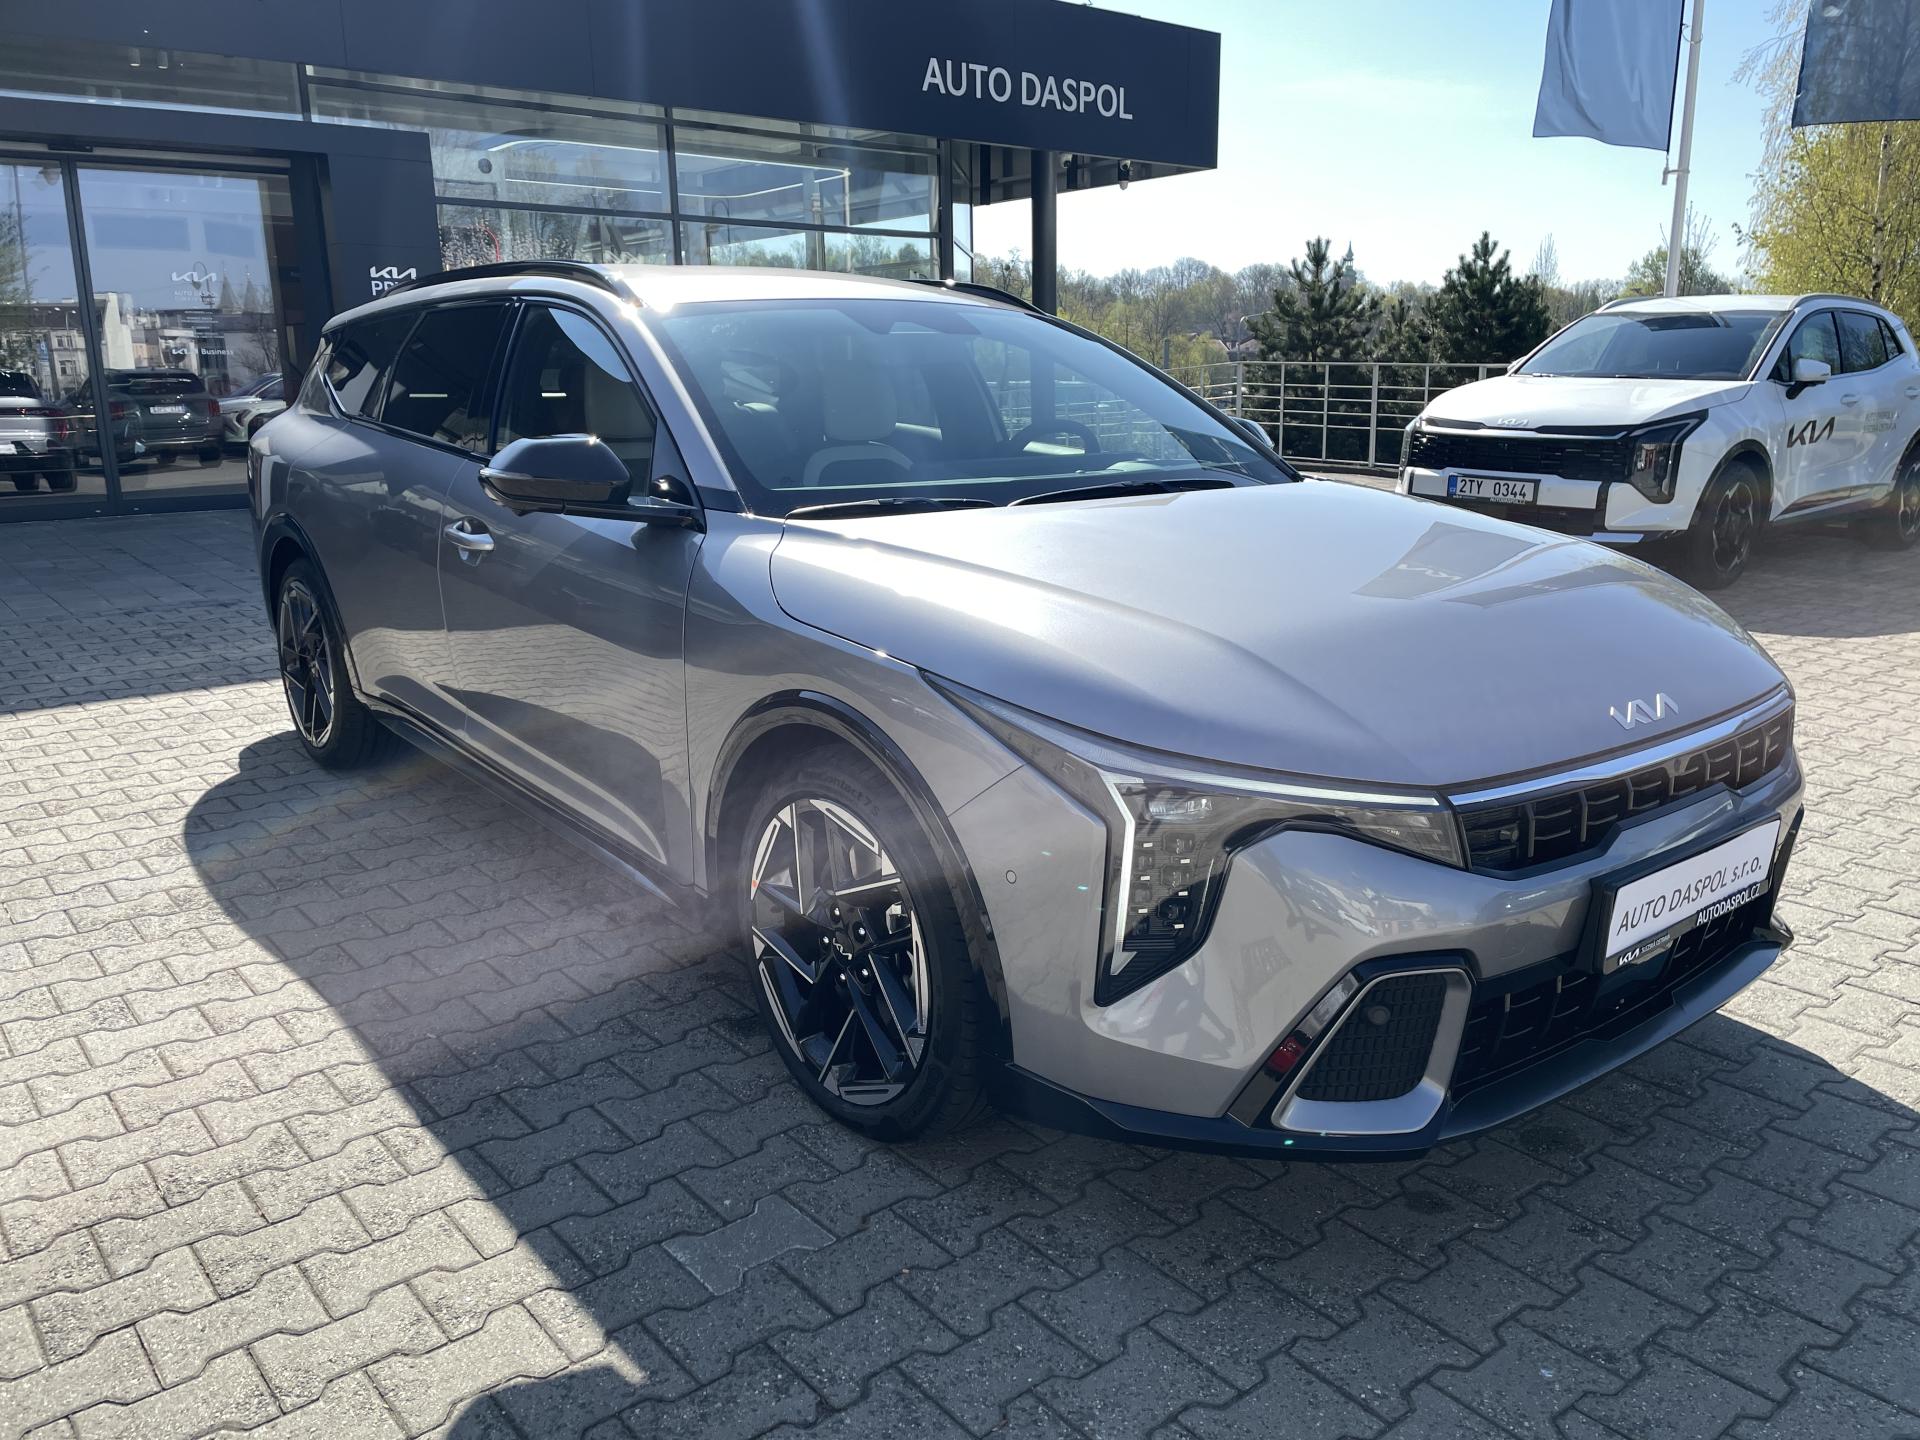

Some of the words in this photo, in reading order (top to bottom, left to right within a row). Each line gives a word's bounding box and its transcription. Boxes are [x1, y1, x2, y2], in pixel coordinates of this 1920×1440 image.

[922, 57, 1012, 103] AUTO
[1021, 71, 1133, 120] DASPOL
[171, 271, 217, 282] KIA
[369, 266, 417, 280] KIA
[201, 348, 234, 356] Business
[1497, 416, 1529, 426] KIA
[1785, 415, 1836, 449] KIA
[1459, 478, 1484, 495] 2TY
[1493, 481, 1527, 499] 0344
[1610, 692, 1680, 730] KIA
[1616, 894, 1667, 937] AUTO
[1668, 868, 1728, 912] DASPOL
[1731, 856, 1762, 883] s.r.o.
[1696, 883, 1762, 926] AUTODASPOL.CZ
[1619, 947, 1640, 966] KIA
